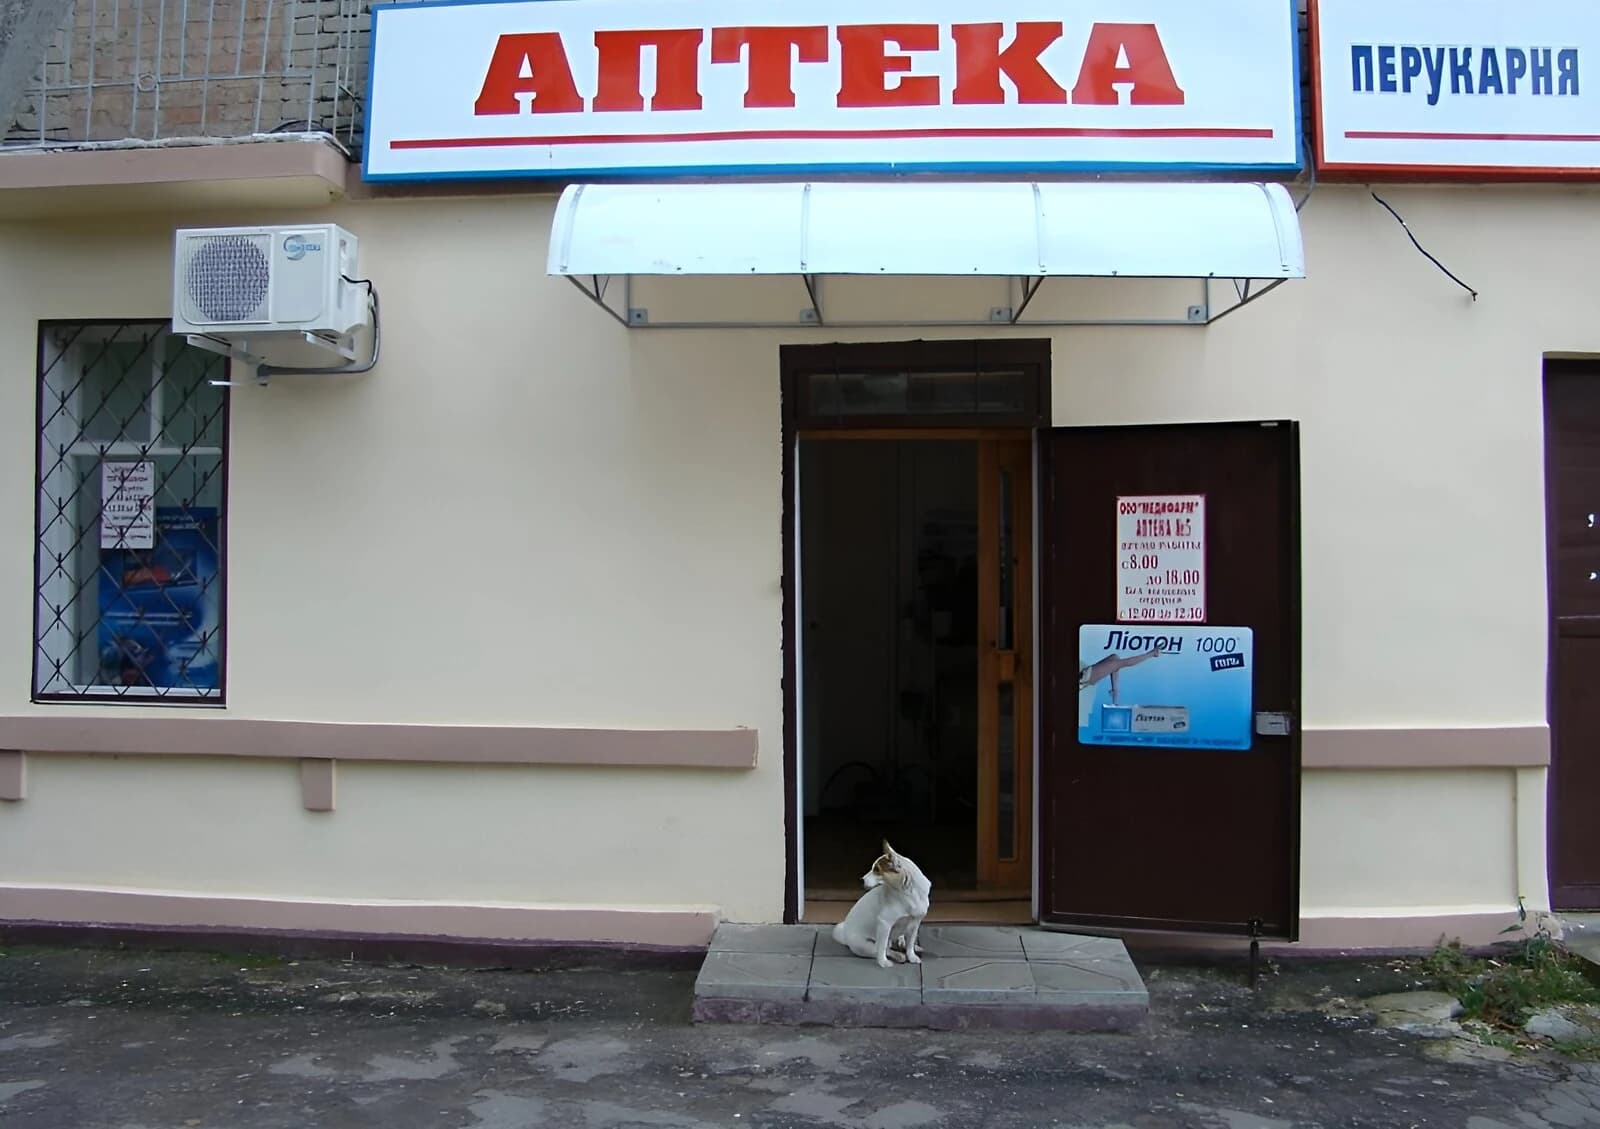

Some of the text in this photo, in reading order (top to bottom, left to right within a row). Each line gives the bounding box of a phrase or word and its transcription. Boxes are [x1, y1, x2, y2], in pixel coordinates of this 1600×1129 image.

[474, 22, 1185, 115] АПТЕКА
[1351, 45, 1580, 106] ПЕРУКАРНЯ
[1136, 519, 1171, 537] АПТЕКА
[1165, 569, 1200, 585] 18.00
[1104, 630, 1237, 653] Ліотон 1000
